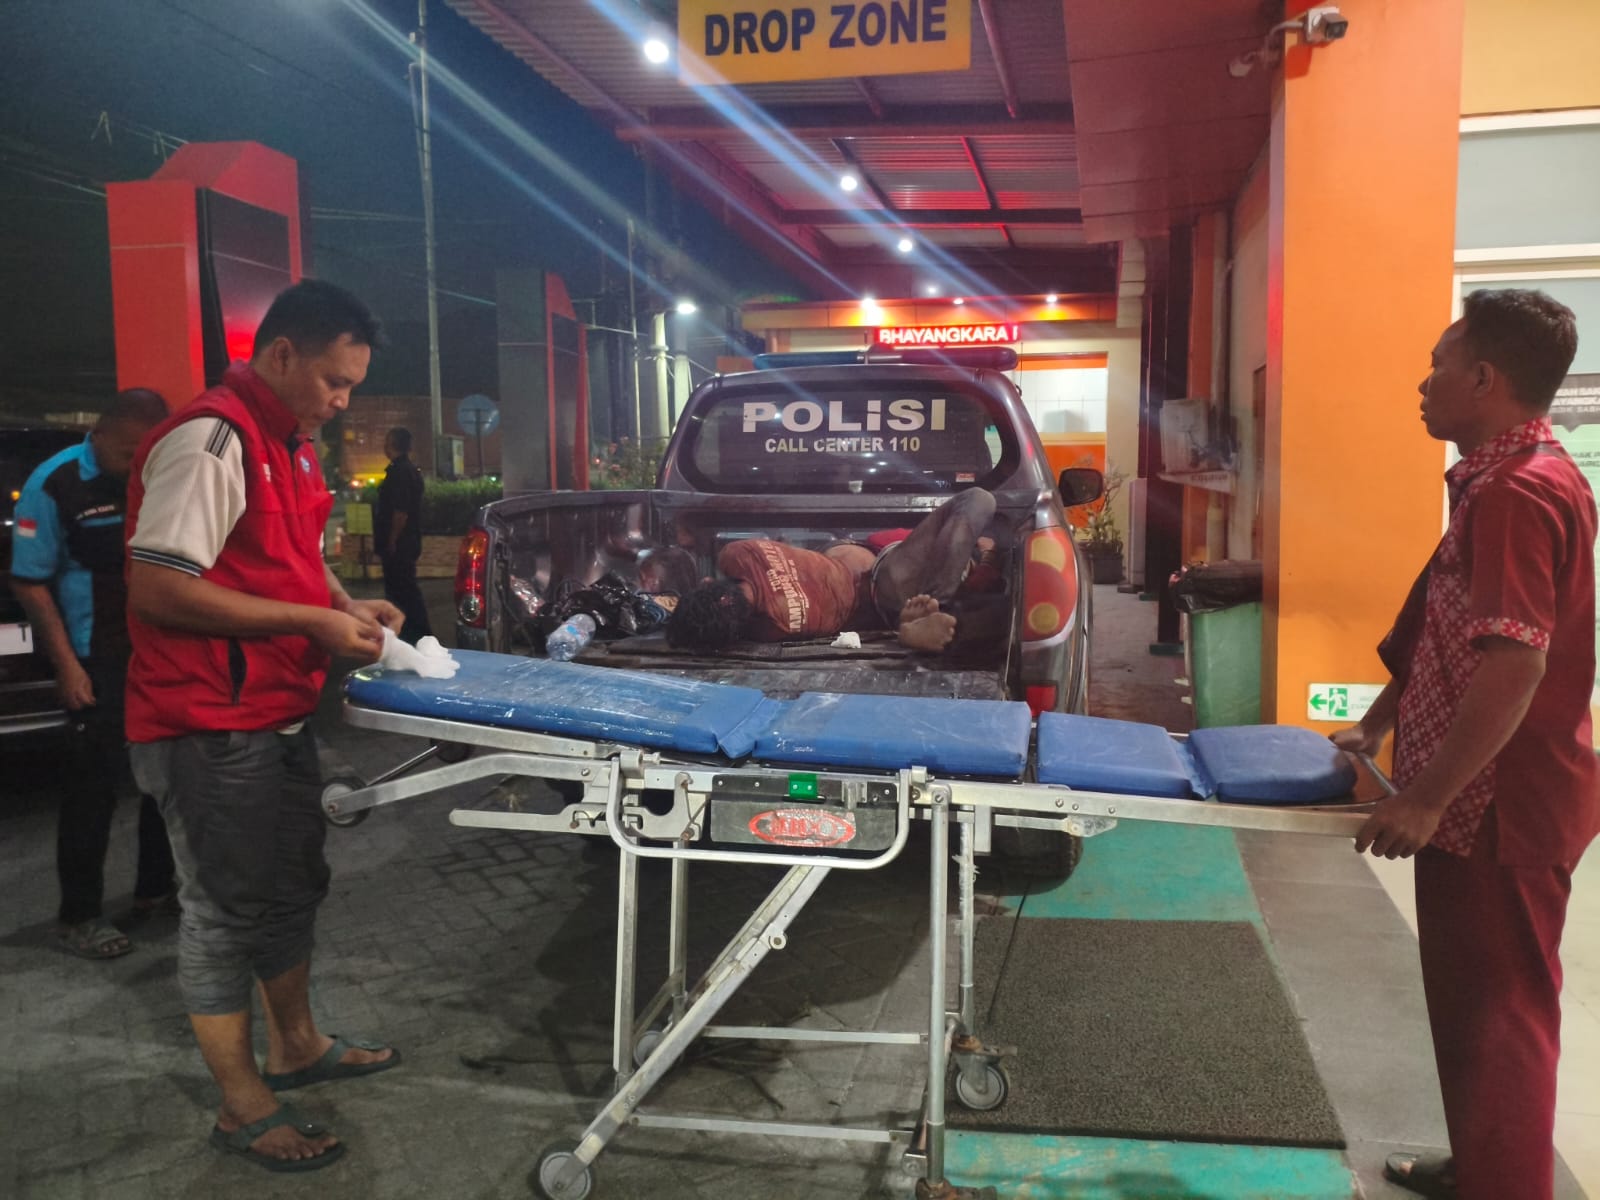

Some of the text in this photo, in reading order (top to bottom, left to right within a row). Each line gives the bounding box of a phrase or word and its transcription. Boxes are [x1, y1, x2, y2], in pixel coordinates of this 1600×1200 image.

[704, 0, 947, 56] DROP ZONE
[879, 326, 1009, 344] BHAYANGKARA
[765, 436, 921, 453] CALL CENTER 110
